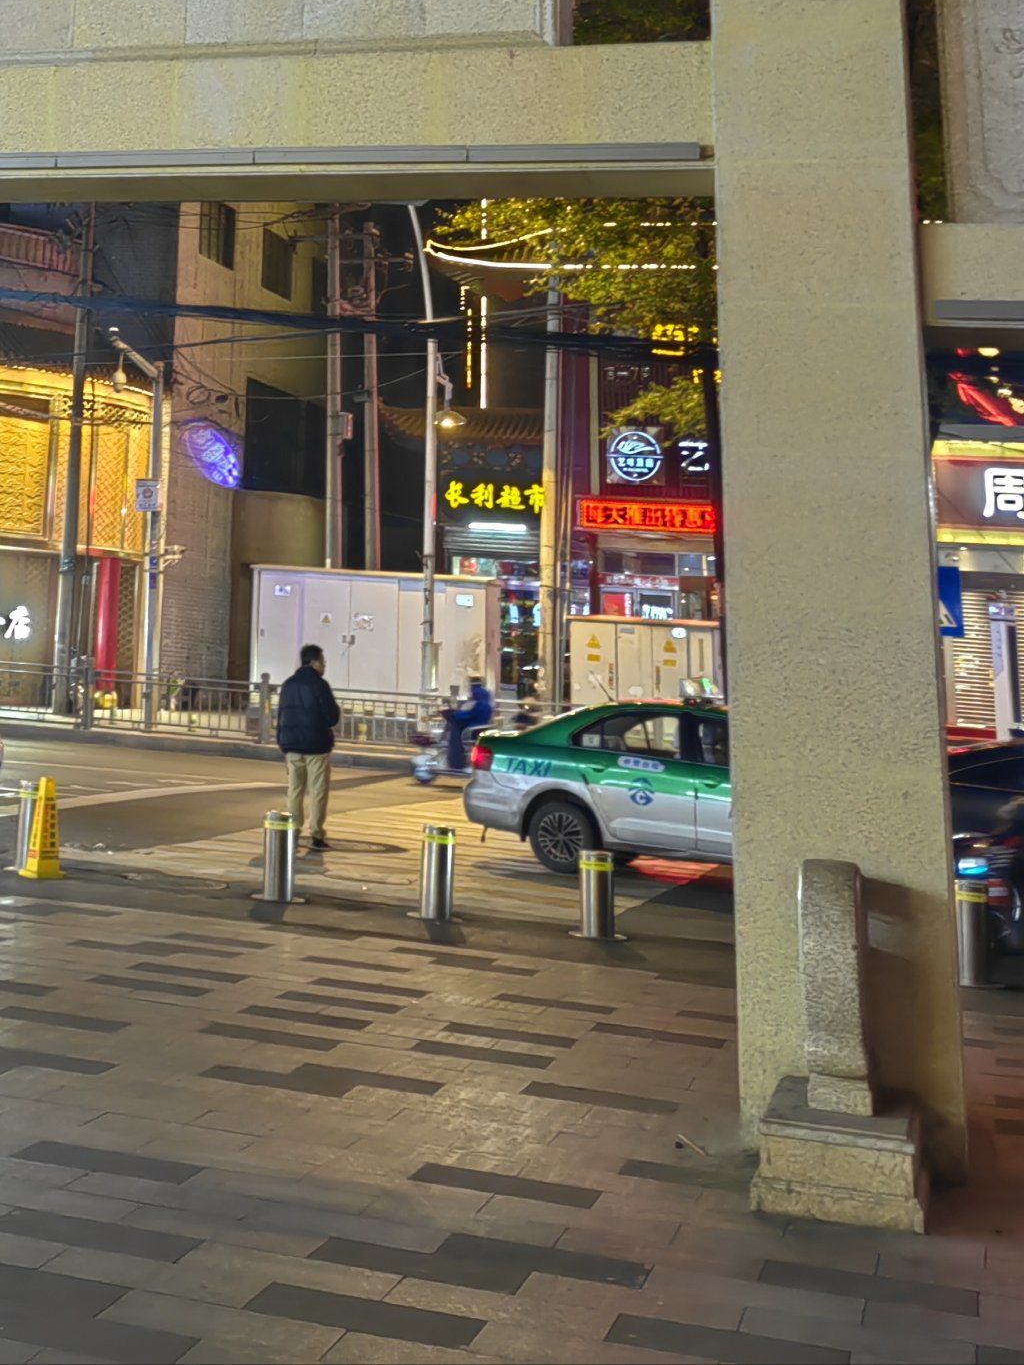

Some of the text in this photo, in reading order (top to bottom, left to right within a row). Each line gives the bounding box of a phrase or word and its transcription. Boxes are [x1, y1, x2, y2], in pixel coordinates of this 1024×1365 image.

[444, 480, 546, 514] 长利超市
[505, 757, 553, 777] TAXI
